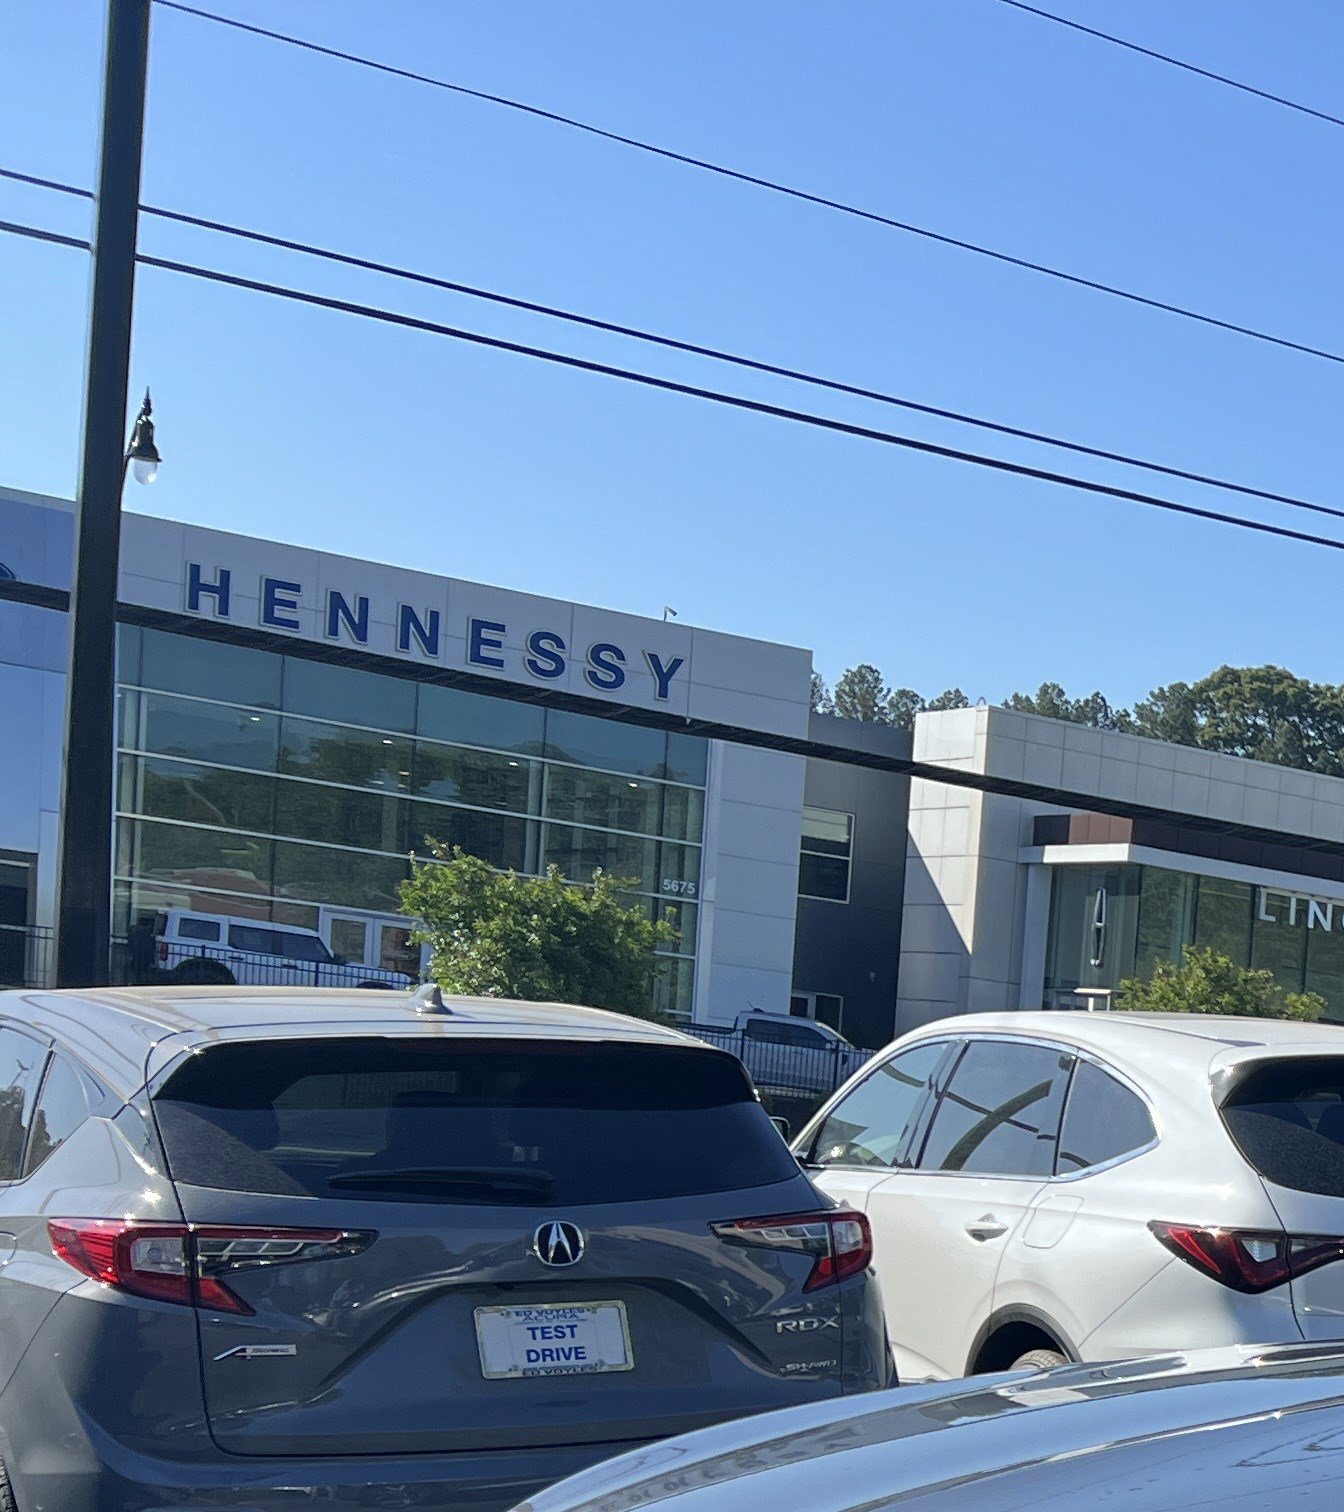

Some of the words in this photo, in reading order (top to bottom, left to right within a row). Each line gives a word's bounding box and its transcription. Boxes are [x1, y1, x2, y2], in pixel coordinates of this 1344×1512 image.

[184, 561, 685, 701] HENNESSY
[662, 878, 696, 895] 5675
[526, 1324, 578, 1341] TEST
[776, 1315, 839, 1334] RDX
[526, 1345, 587, 1364] DRIVE
